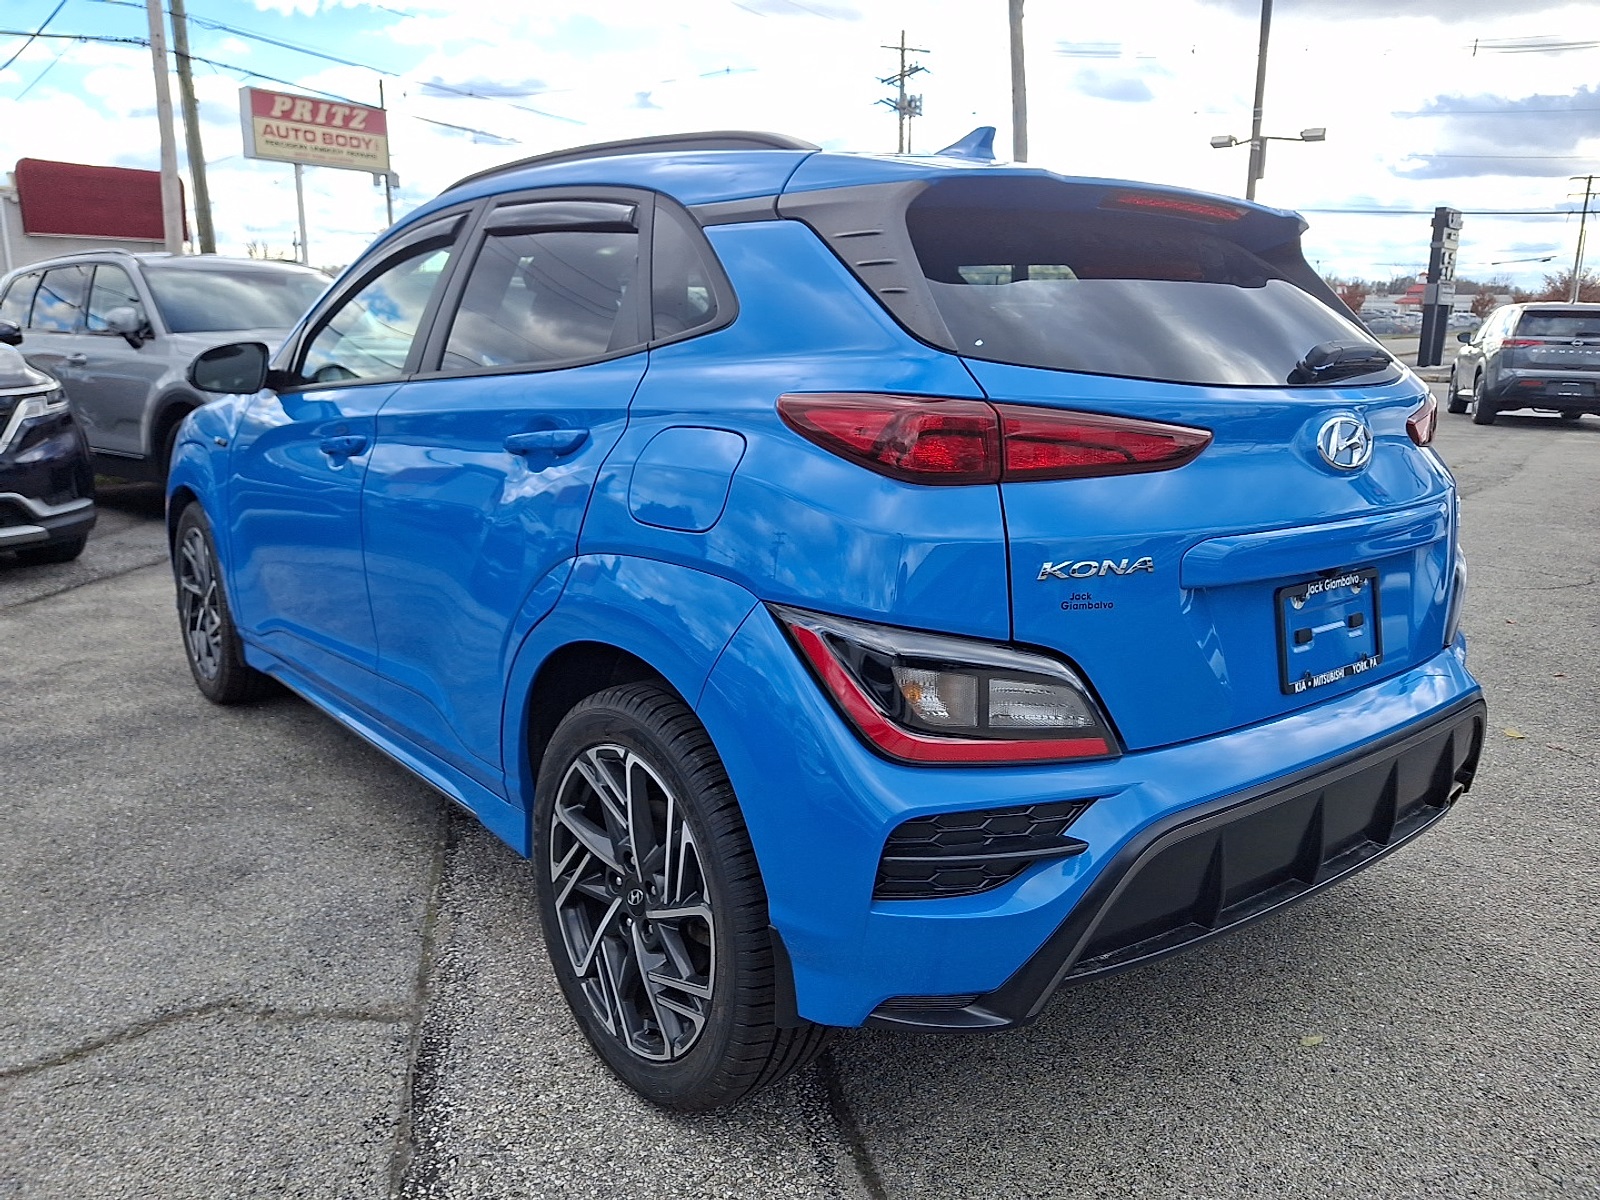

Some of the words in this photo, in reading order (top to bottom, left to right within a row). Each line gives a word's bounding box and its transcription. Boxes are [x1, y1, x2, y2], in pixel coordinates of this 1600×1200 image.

[271, 96, 369, 130] PRITZ
[263, 124, 316, 143] AUTO
[322, 133, 373, 150] BODY
[1037, 556, 1155, 580] KONA
[1069, 592, 1092, 601] Jack
[1307, 583, 1324, 595] Jack
[1324, 575, 1360, 591] Giambalvo
[1060, 601, 1114, 611] Giambalvo
[1294, 681, 1307, 693] KIA
[1312, 667, 1345, 687] MITSUBISHI
[1369, 658, 1378, 668] PA
